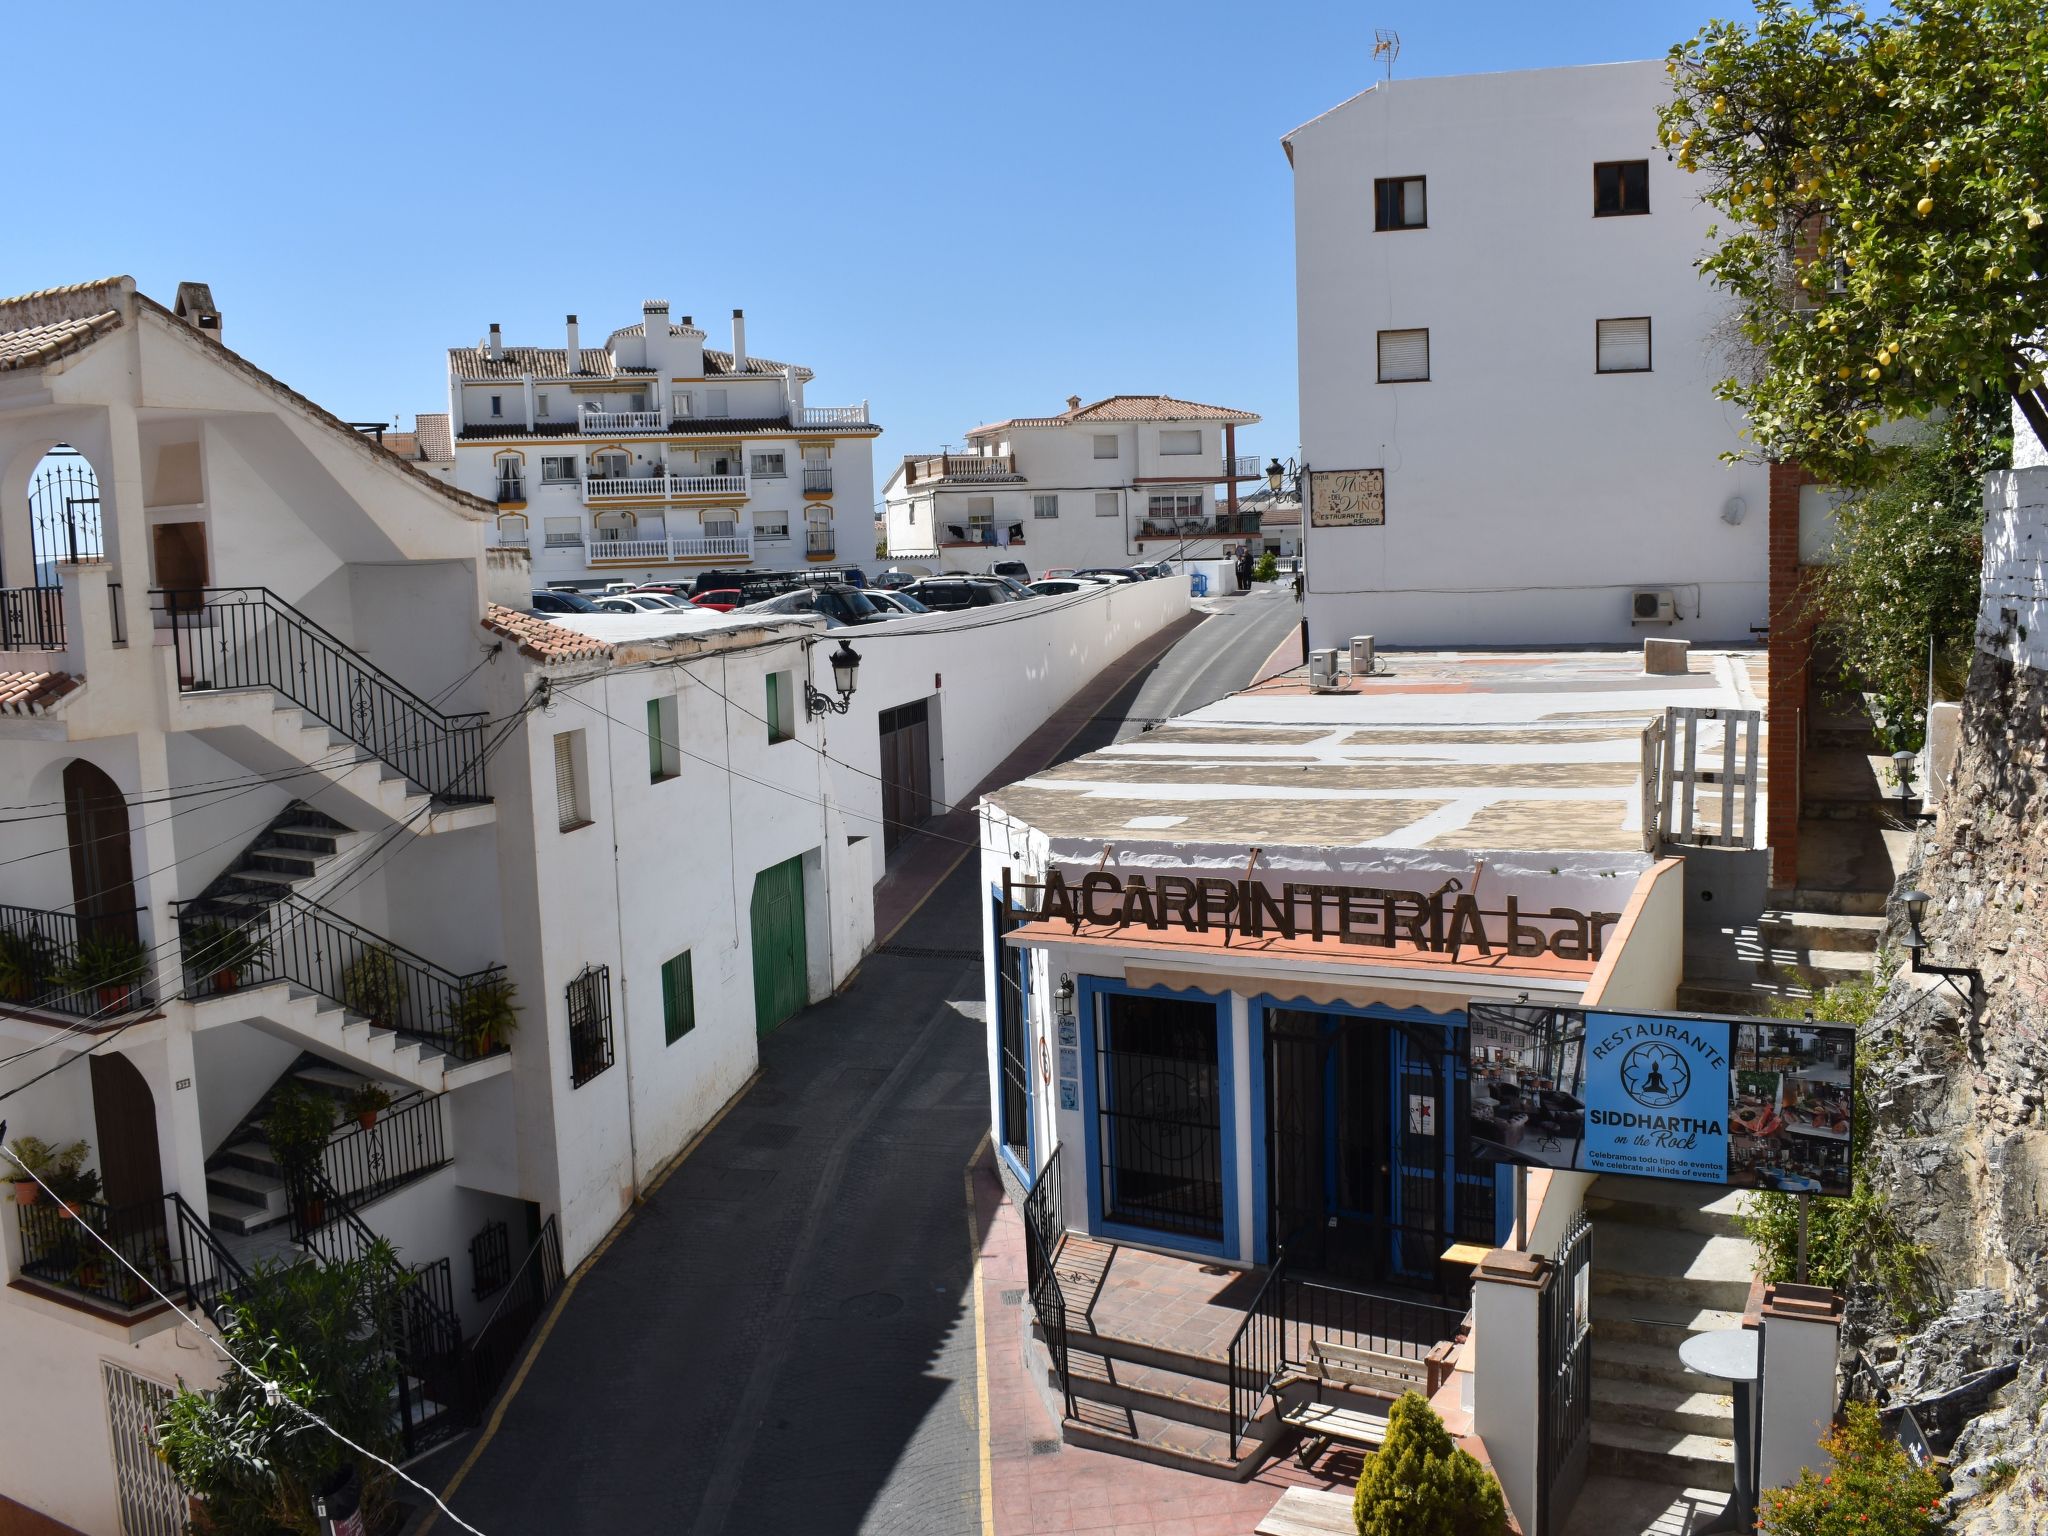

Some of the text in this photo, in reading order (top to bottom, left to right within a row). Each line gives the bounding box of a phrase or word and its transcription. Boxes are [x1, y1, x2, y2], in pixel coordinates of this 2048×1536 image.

[1332, 475, 1381, 493] MUSEO
[1340, 496, 1380, 511] VINO
[1315, 512, 1364, 520] RESTAURANTE
[1002, 867, 1074, 924] LA
[1507, 895, 1622, 962] bar
[1592, 1023, 1726, 1070] RESTAURANTE
[1590, 1109, 1723, 1136] SIDDHARTHA
[1614, 1129, 1698, 1150] on the Rock
[1589, 1150, 1723, 1170] Celebramos todo tipo de eventos
[1591, 1159, 1604, 1167] We
[1606, 1161, 1643, 1171] celebrate
[1645, 1165, 1655, 1173] all
[1657, 1166, 1680, 1175] kinds
[1693, 1171, 1720, 1179] events
